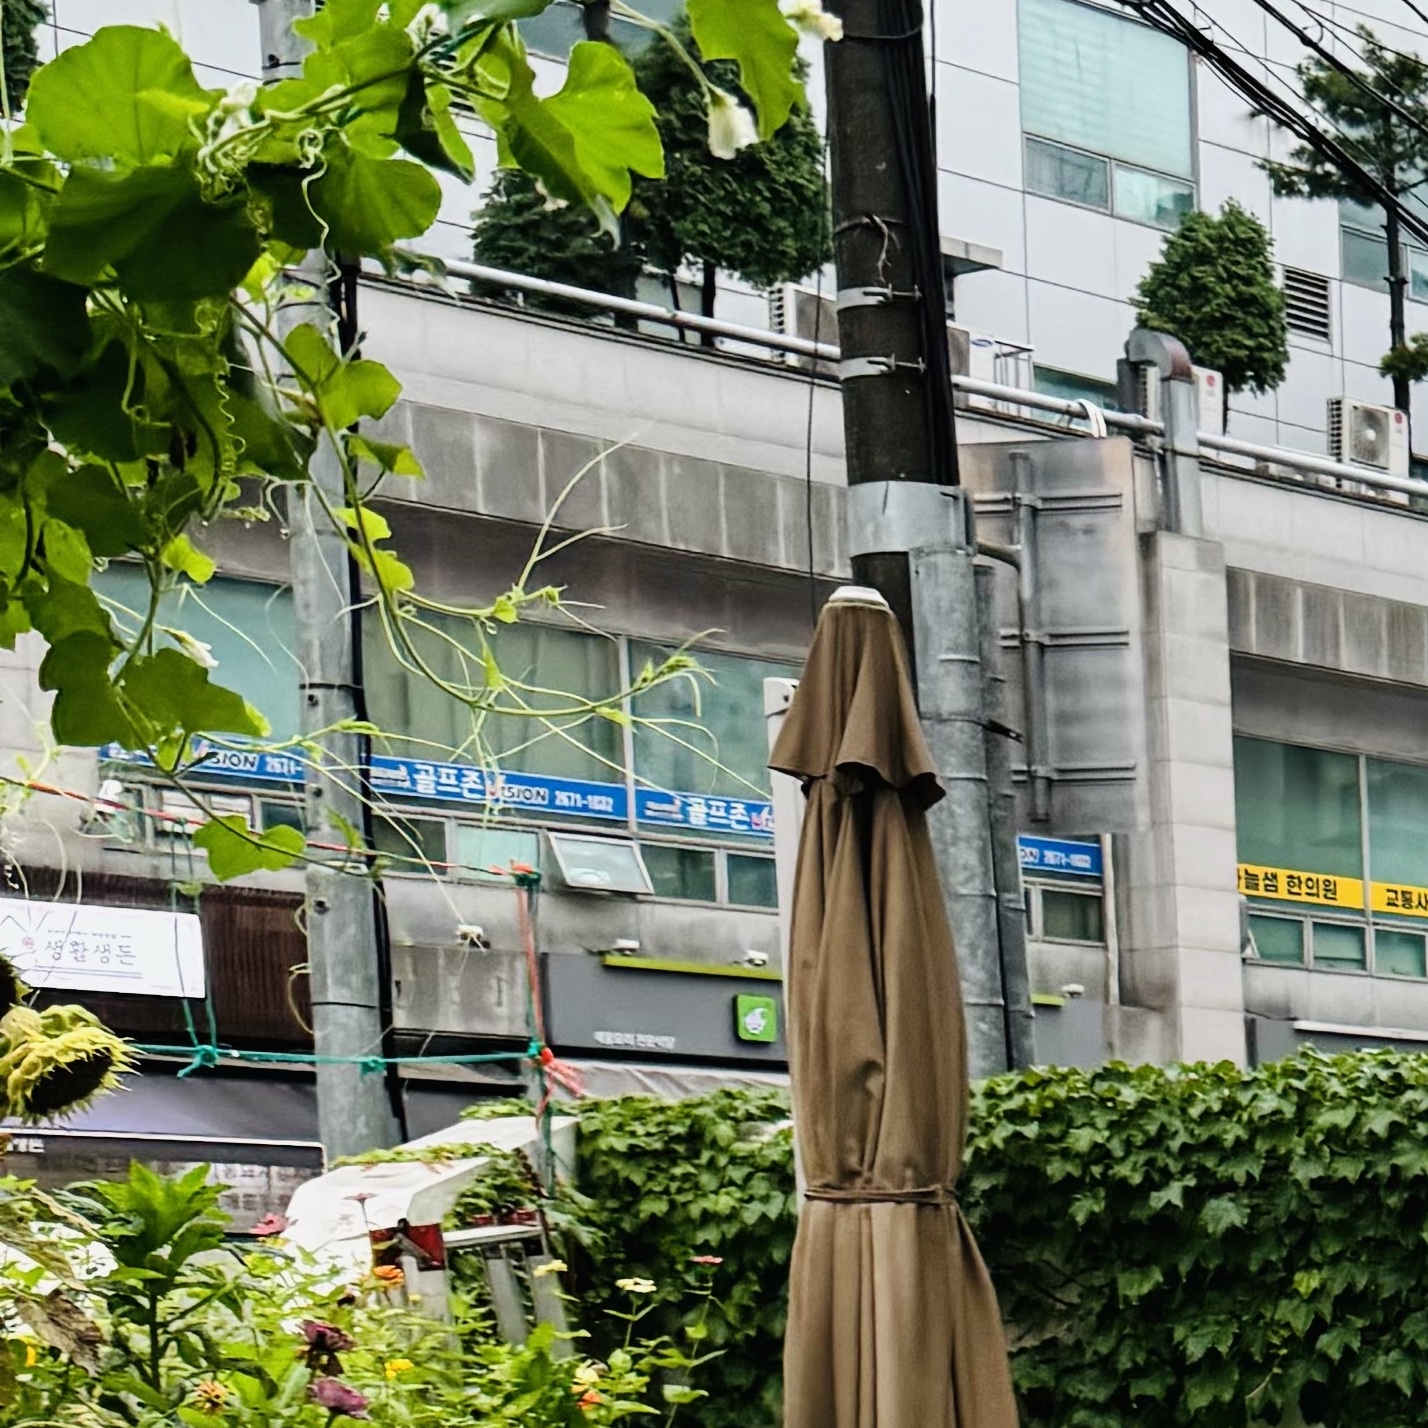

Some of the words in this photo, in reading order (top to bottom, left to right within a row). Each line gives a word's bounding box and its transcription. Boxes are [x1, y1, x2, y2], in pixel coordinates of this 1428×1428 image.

[413, 763, 483, 798] 골프존
[686, 797, 750, 830] 골프존
[1286, 874, 1338, 901] 한의원
